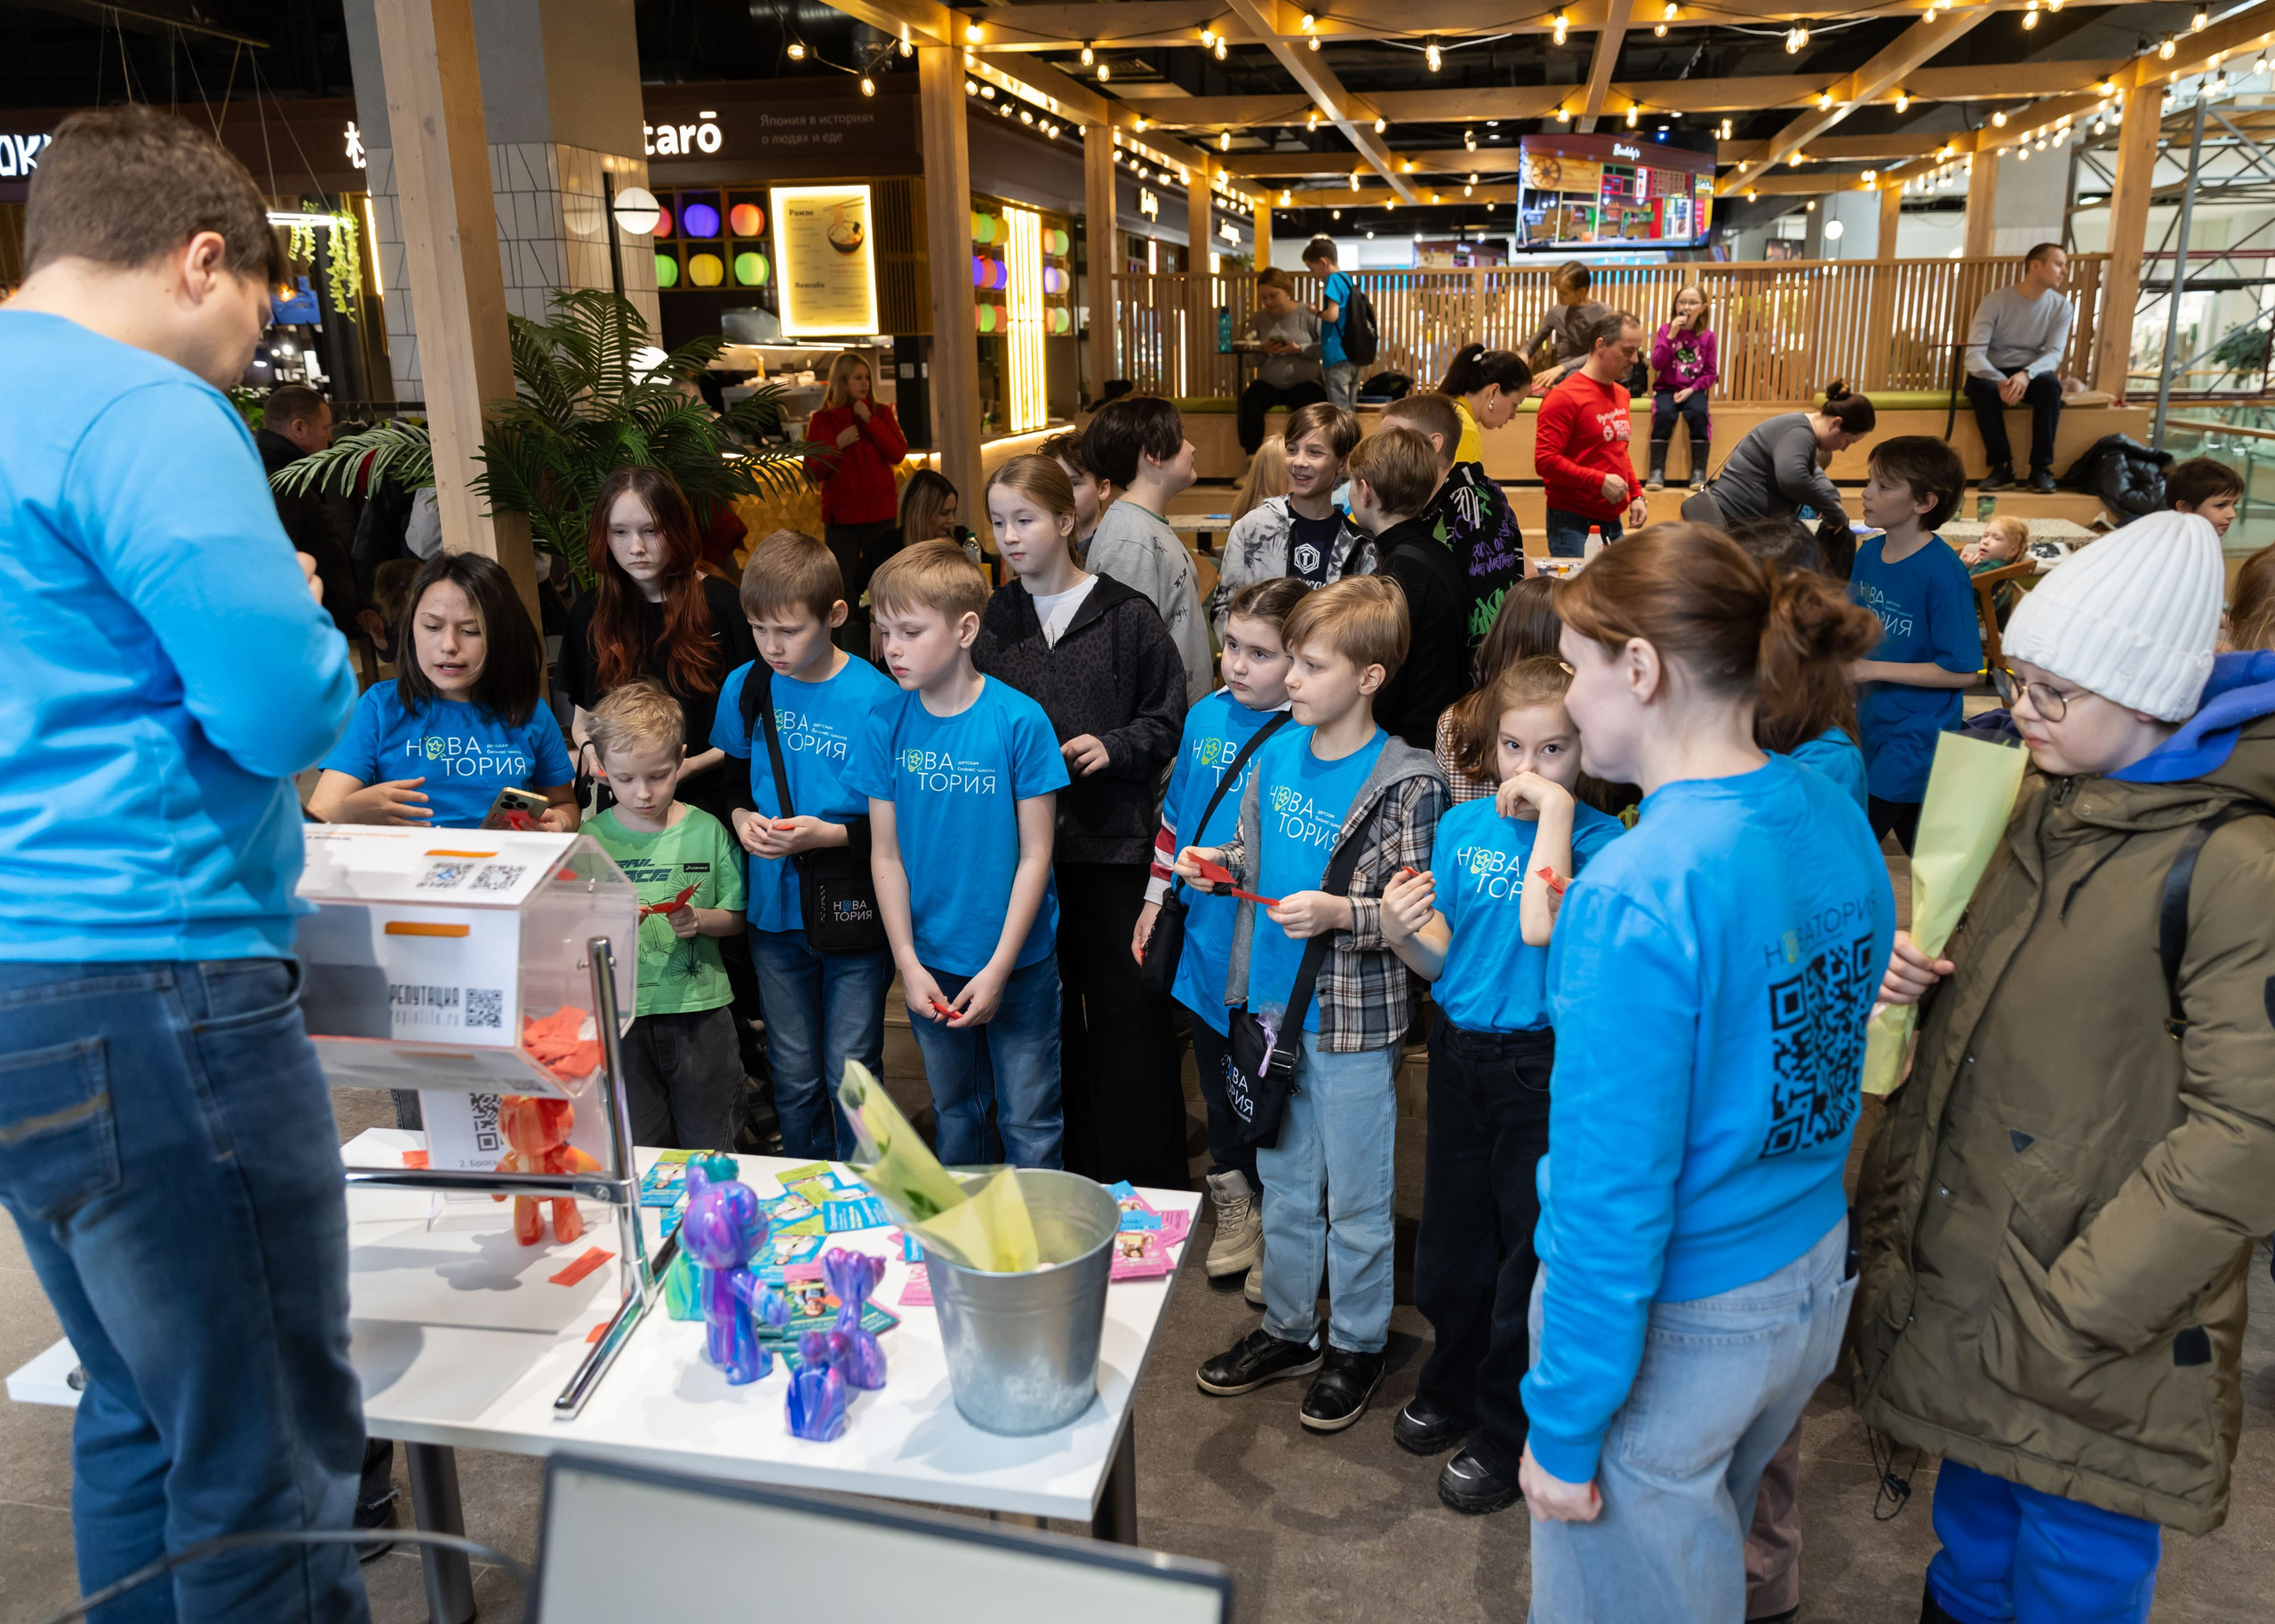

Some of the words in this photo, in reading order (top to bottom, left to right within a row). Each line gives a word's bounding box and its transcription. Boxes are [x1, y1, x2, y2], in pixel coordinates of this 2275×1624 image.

[760, 114, 806, 127] Япония
[810, 116, 816, 125] в
[818, 113, 874, 126] историях
[772, 134, 809, 145] людях
[812, 134, 819, 143] и
[822, 133, 843, 143] еде
[1613, 143, 1640, 161] Buddy's
[783, 731, 847, 760] ОРИЯ
[441, 756, 526, 776] ТОРИЯ
[917, 772, 996, 794] ТОРИЯ
[1315, 816, 1342, 830] бизнес-шко
[1477, 873, 1524, 901] ТОР
[834, 910, 873, 921] ТОРИЯ
[390, 983, 459, 1009] РЕПУТАЦИЯ
